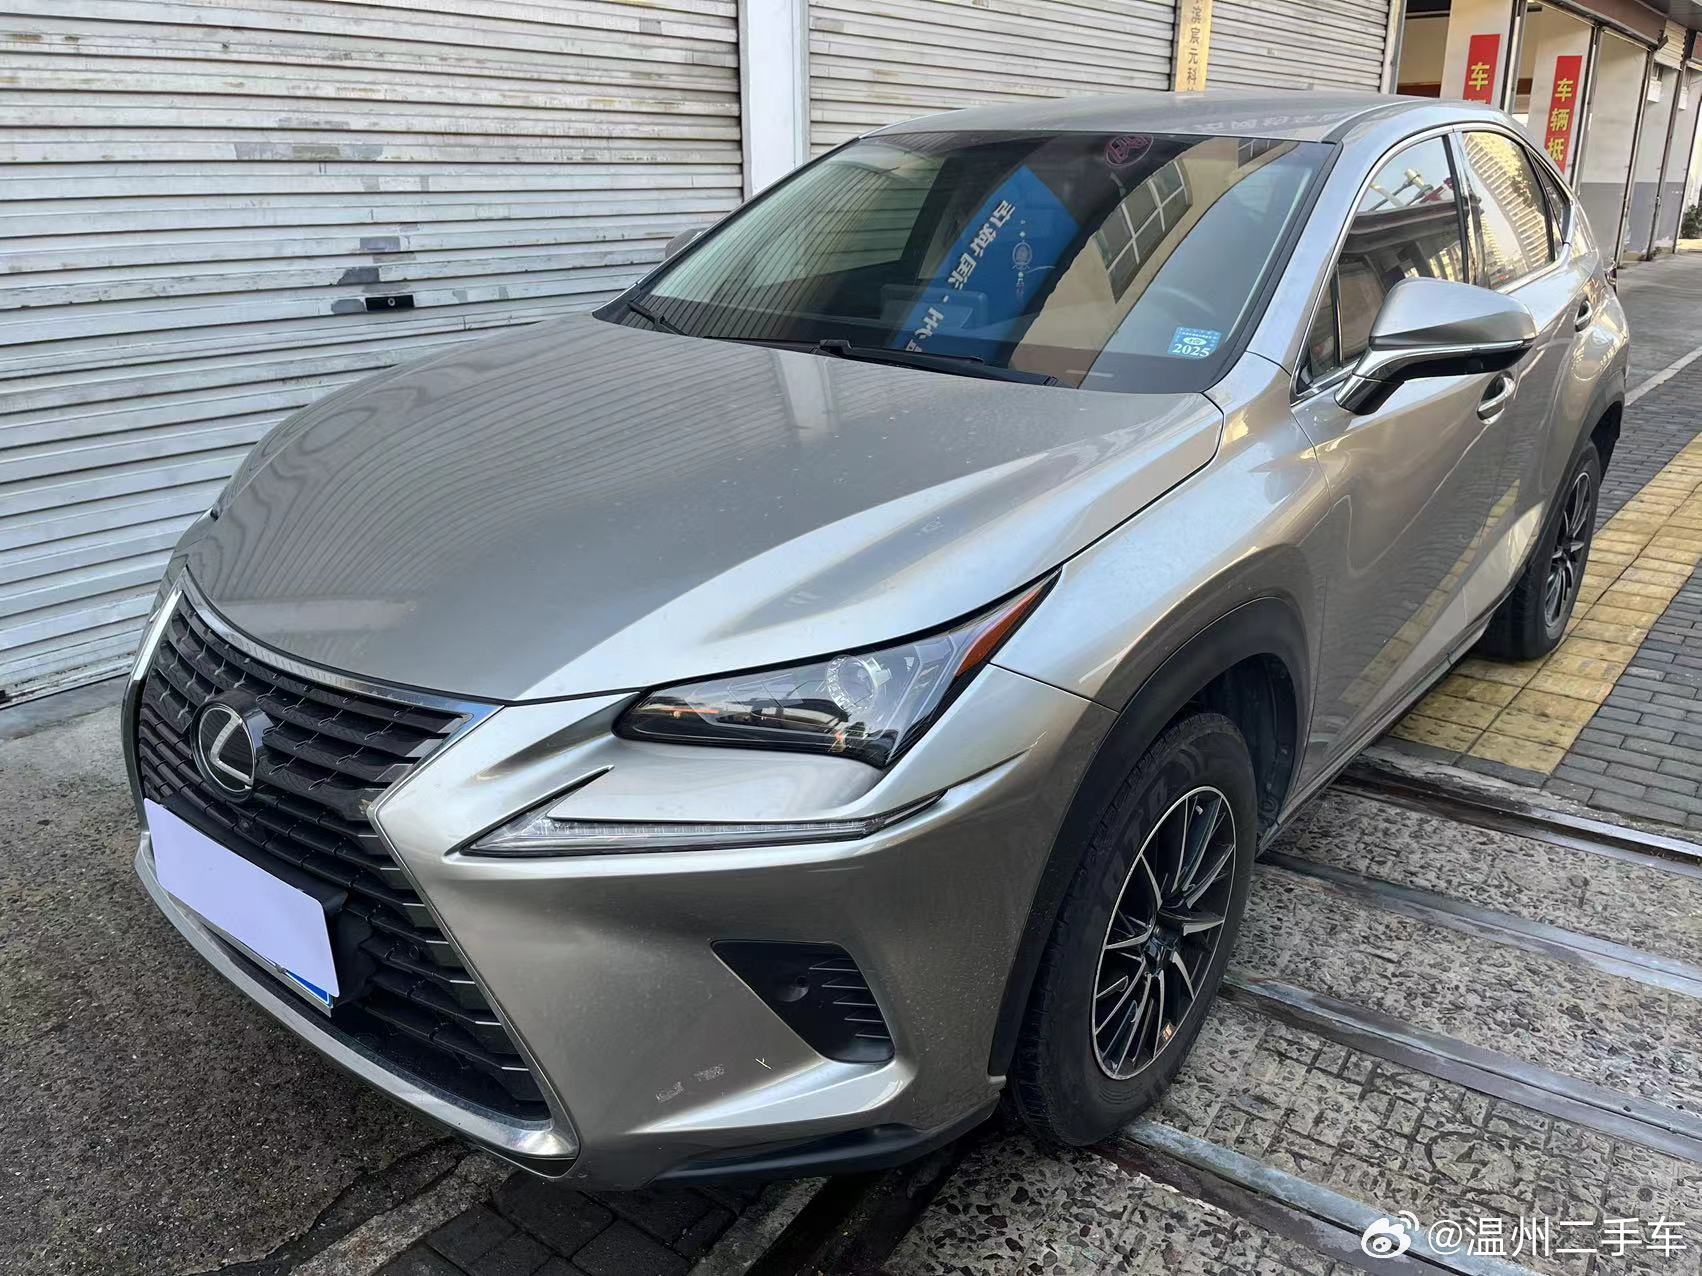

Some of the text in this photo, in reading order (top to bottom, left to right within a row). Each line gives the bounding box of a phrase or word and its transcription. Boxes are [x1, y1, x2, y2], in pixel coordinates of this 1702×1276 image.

[1186, 0, 1202, 92] 滨宸元科
[1468, 61, 1491, 103] 车
[1547, 77, 1574, 161] 车辆抵
[1172, 343, 1211, 357] 2025
